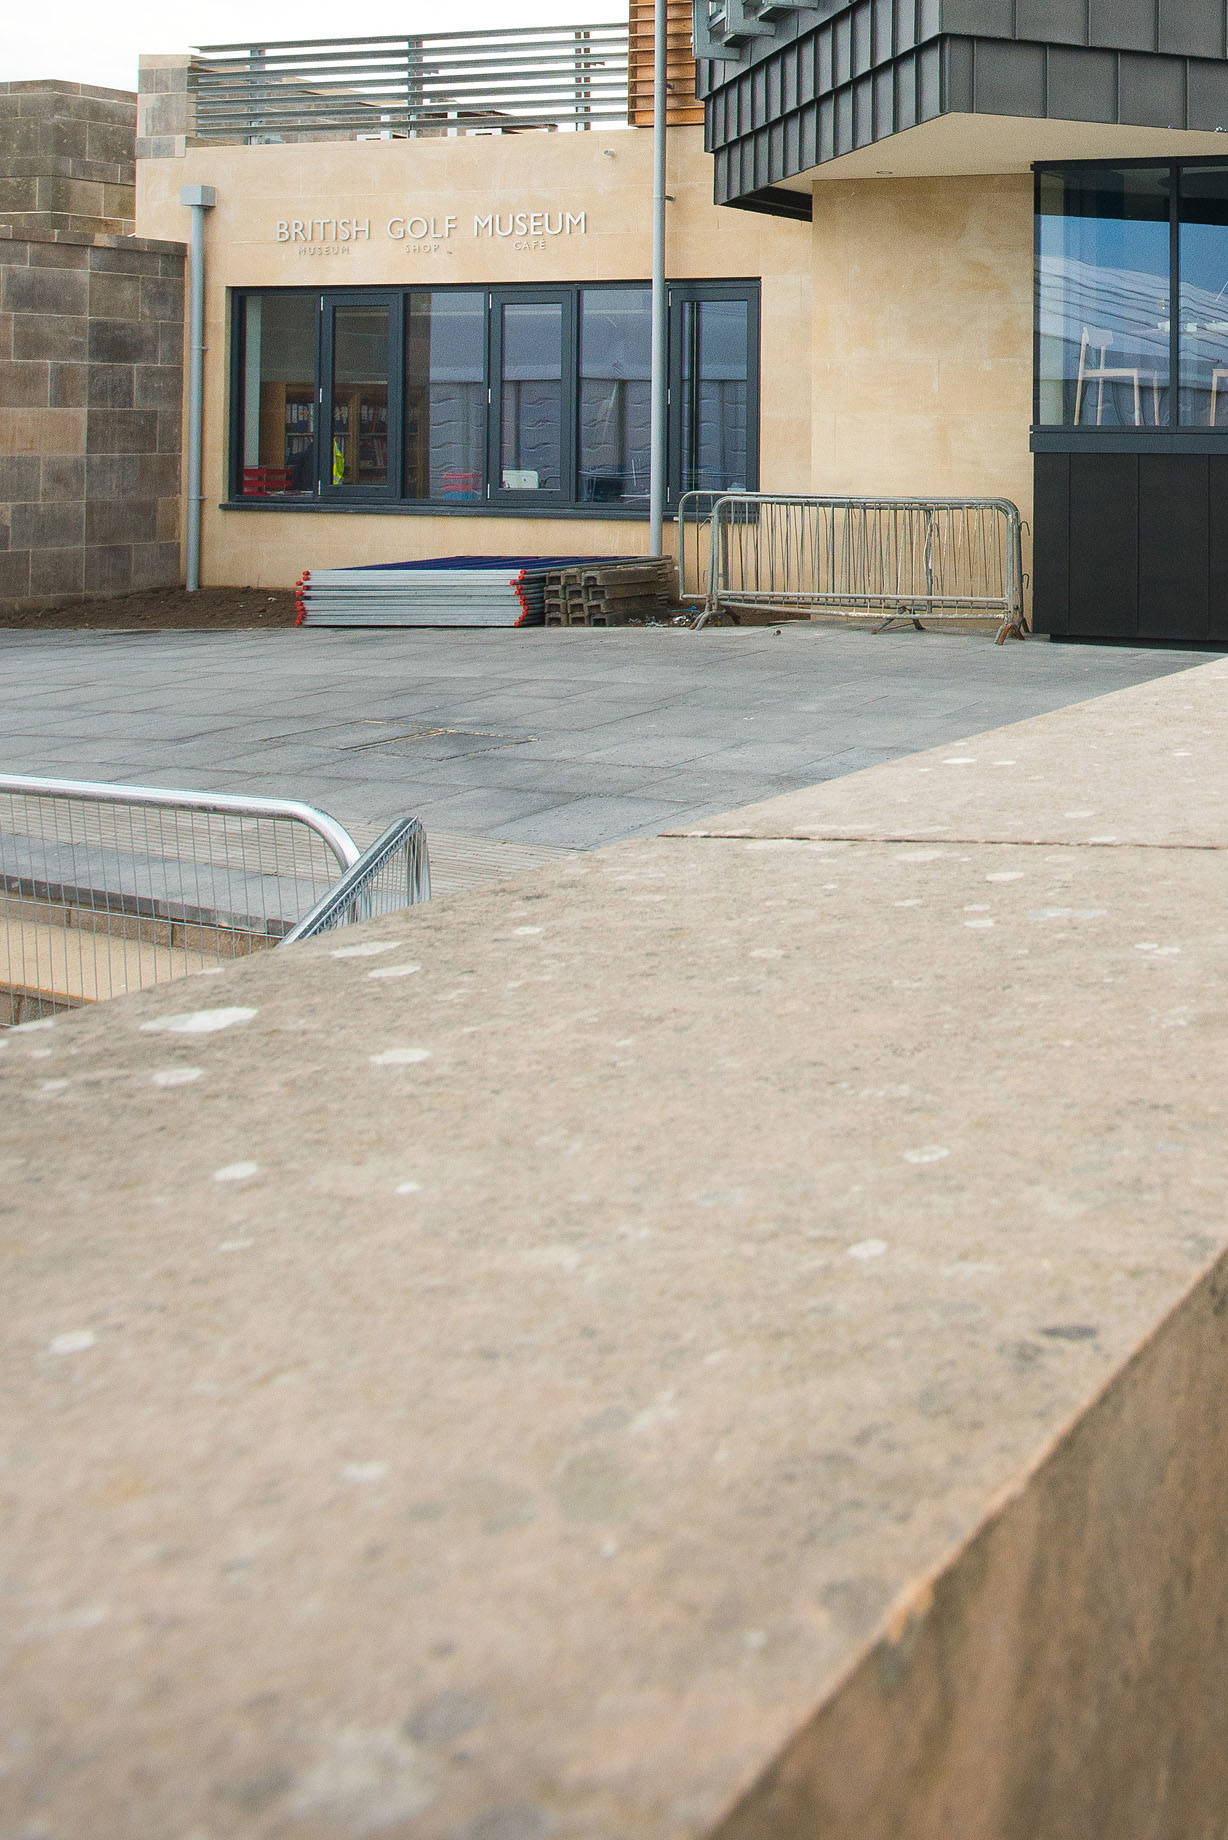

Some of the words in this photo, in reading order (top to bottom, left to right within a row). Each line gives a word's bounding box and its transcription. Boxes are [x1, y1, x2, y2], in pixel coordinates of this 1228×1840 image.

[276, 218, 371, 242] BRITISH
[387, 215, 457, 240] GOLF
[474, 211, 587, 237] MUSEUM
[298, 245, 350, 256] MUSEUM
[405, 243, 440, 254] SHOP
[513, 239, 547, 251] CAFÉ
